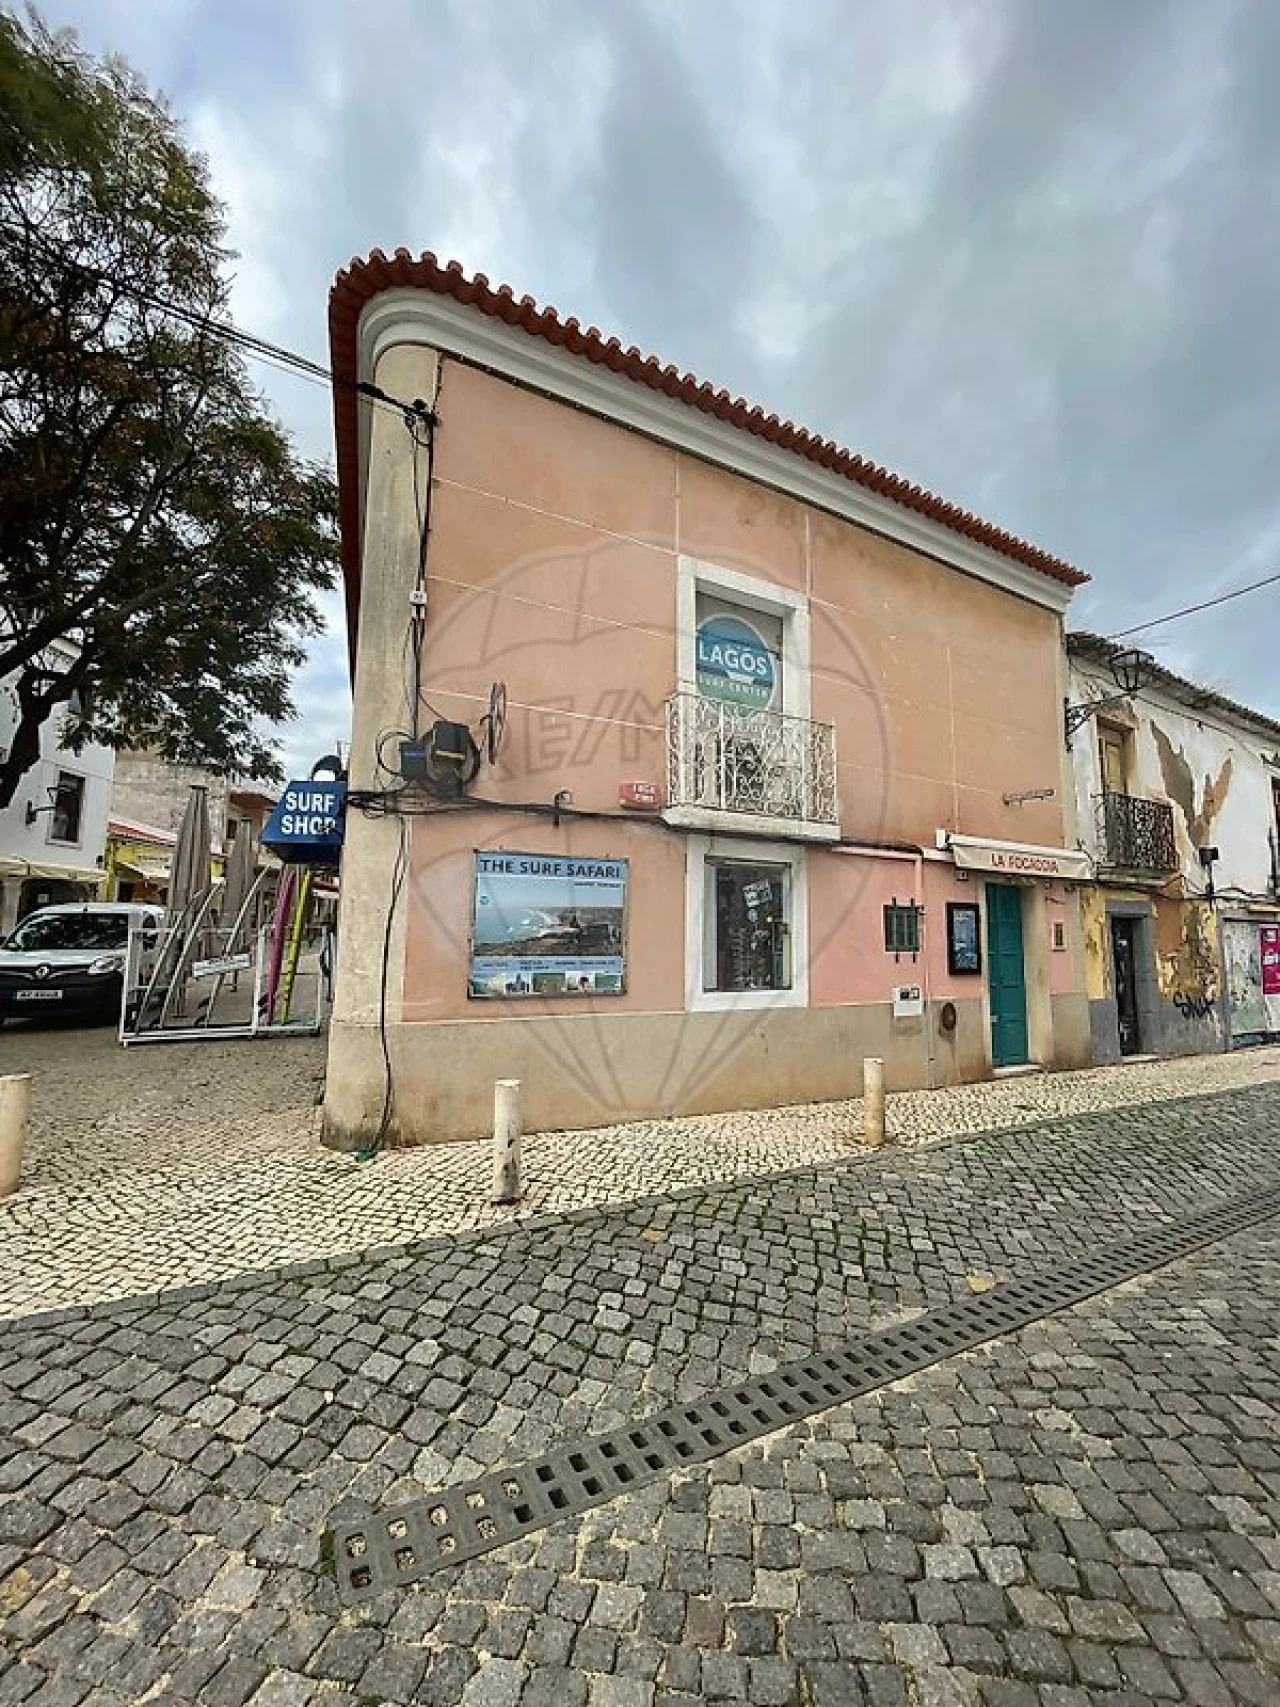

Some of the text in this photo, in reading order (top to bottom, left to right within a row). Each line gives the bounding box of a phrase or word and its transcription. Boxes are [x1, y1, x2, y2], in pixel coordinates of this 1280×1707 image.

[699, 640, 767, 676] LAGOS
[285, 791, 335, 813] SURF
[281, 814, 336, 835] SHOP
[480, 859, 620, 878] THE SURF SAFARI
[991, 853, 1006, 867] LA
